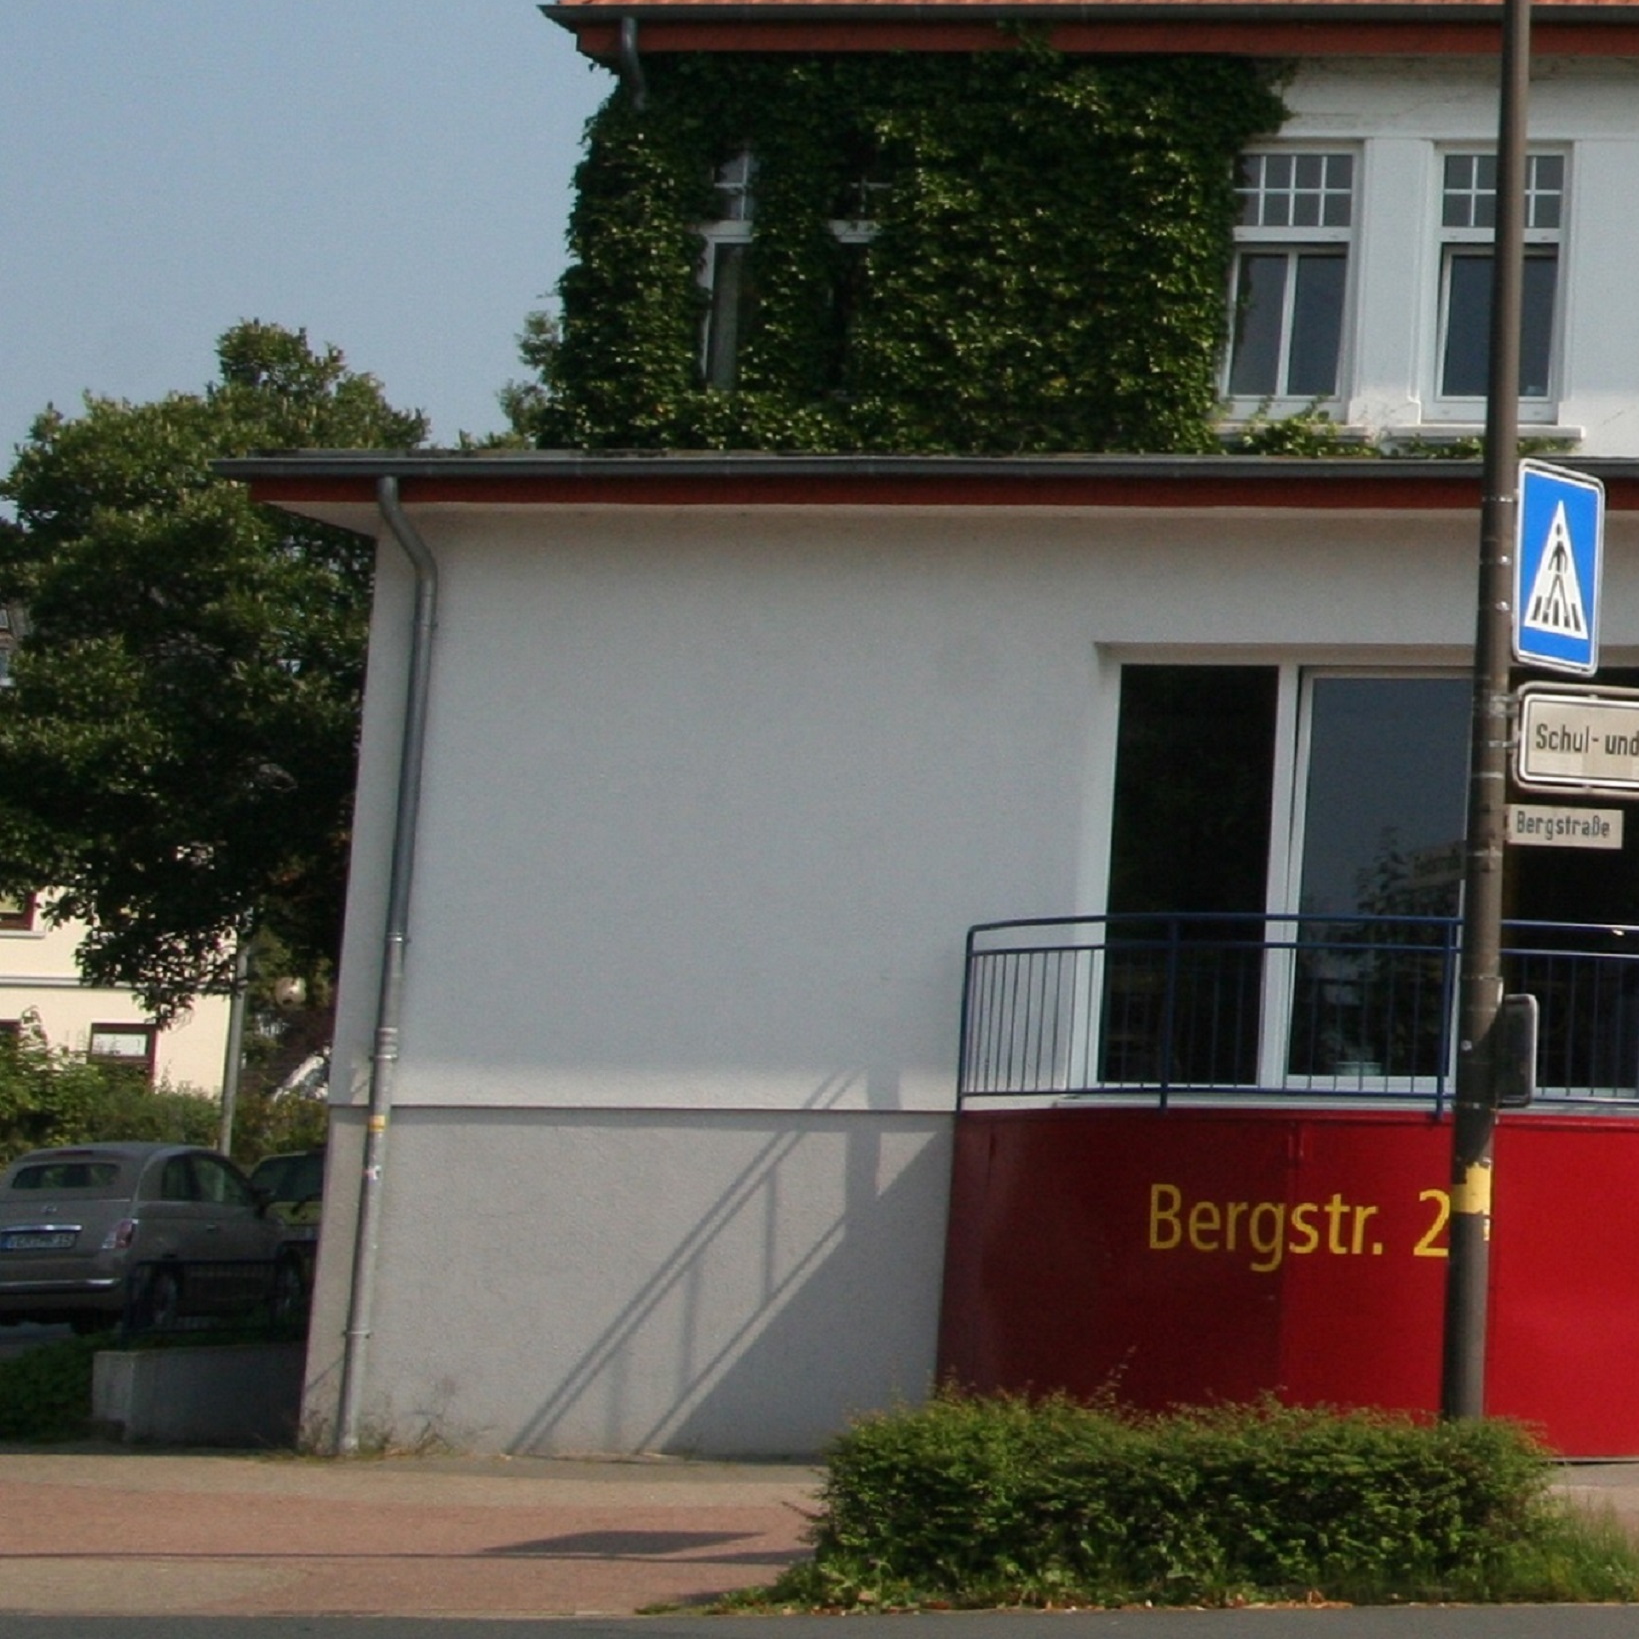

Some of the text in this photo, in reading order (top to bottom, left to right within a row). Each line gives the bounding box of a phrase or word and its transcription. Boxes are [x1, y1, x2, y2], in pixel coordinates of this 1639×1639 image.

[1535, 723, 1599, 753] Schul-
[1516, 814, 1610, 840] Bergstraße
[1149, 1183, 1383, 1272] Bergstr.
